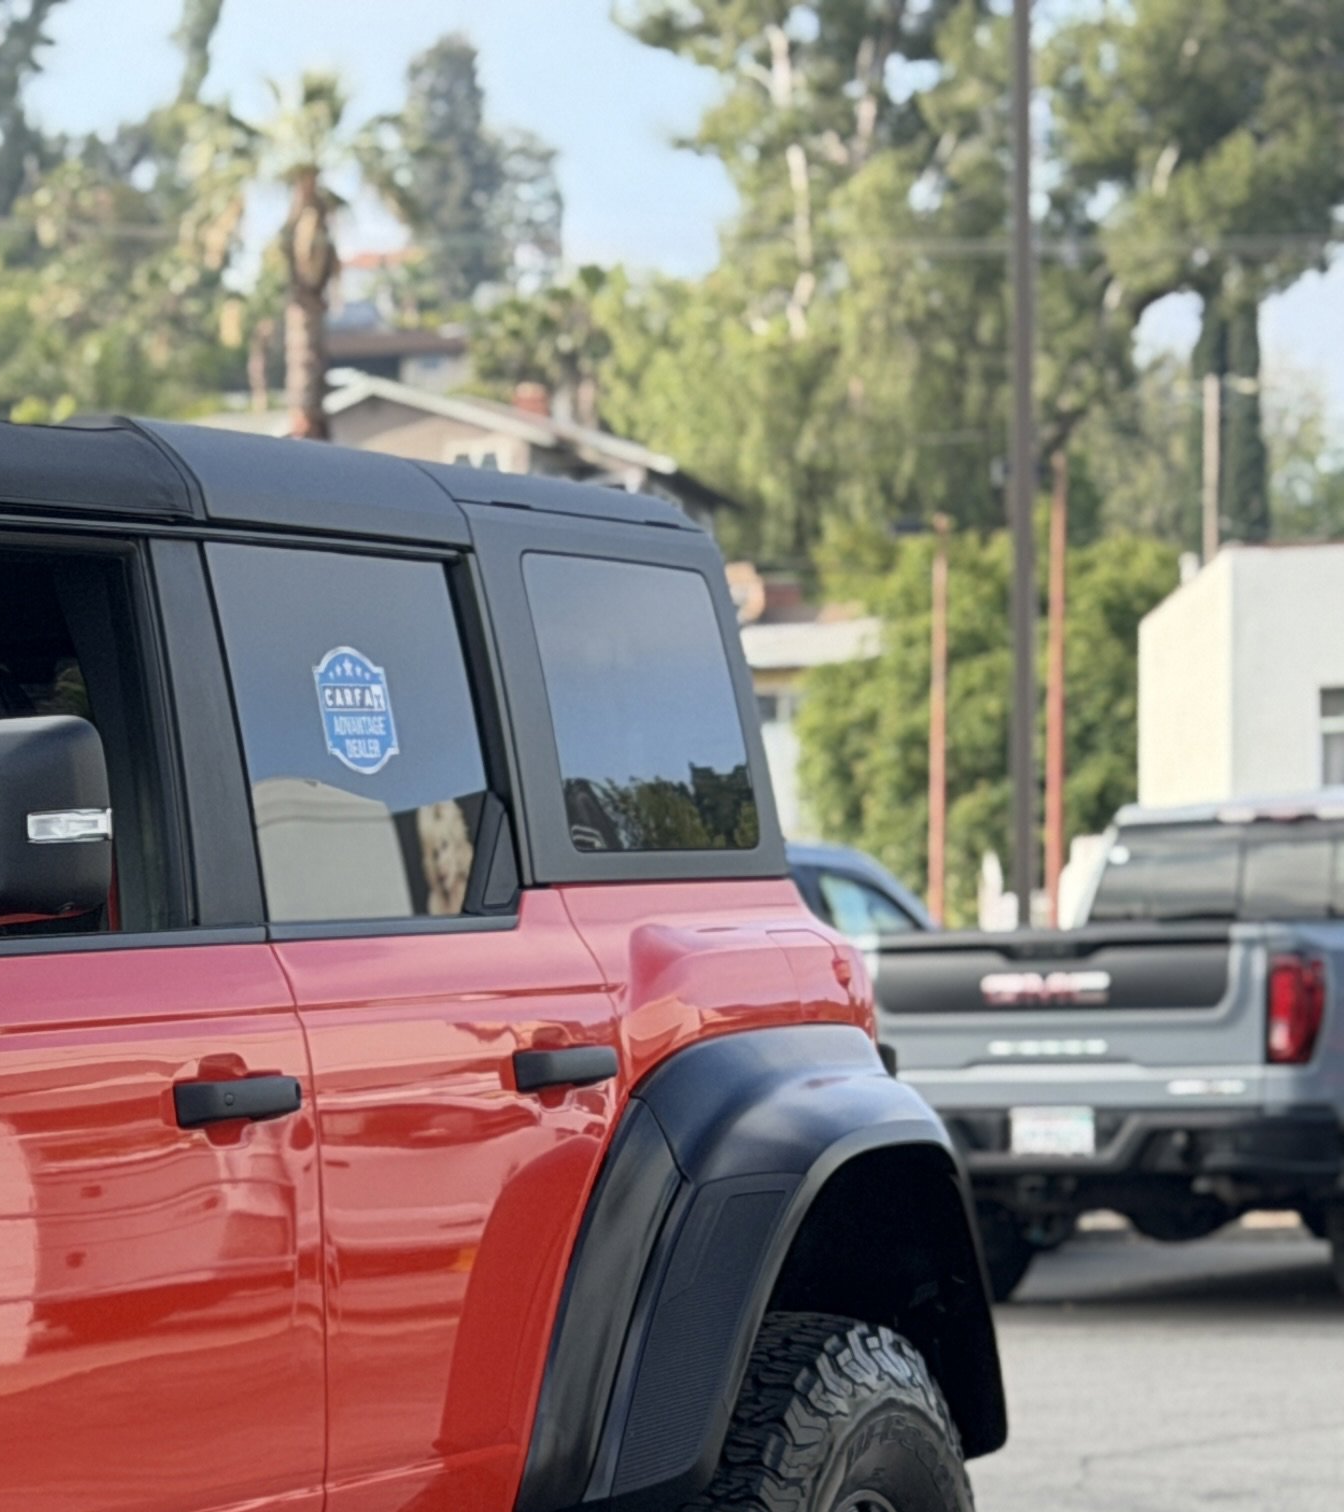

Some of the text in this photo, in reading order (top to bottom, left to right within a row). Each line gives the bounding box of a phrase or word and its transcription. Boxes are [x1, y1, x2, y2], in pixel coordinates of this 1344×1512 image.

[323, 686, 386, 709] CARFAX
[333, 715, 387, 736] ADVANTAGE
[345, 738, 382, 759] DEALER
